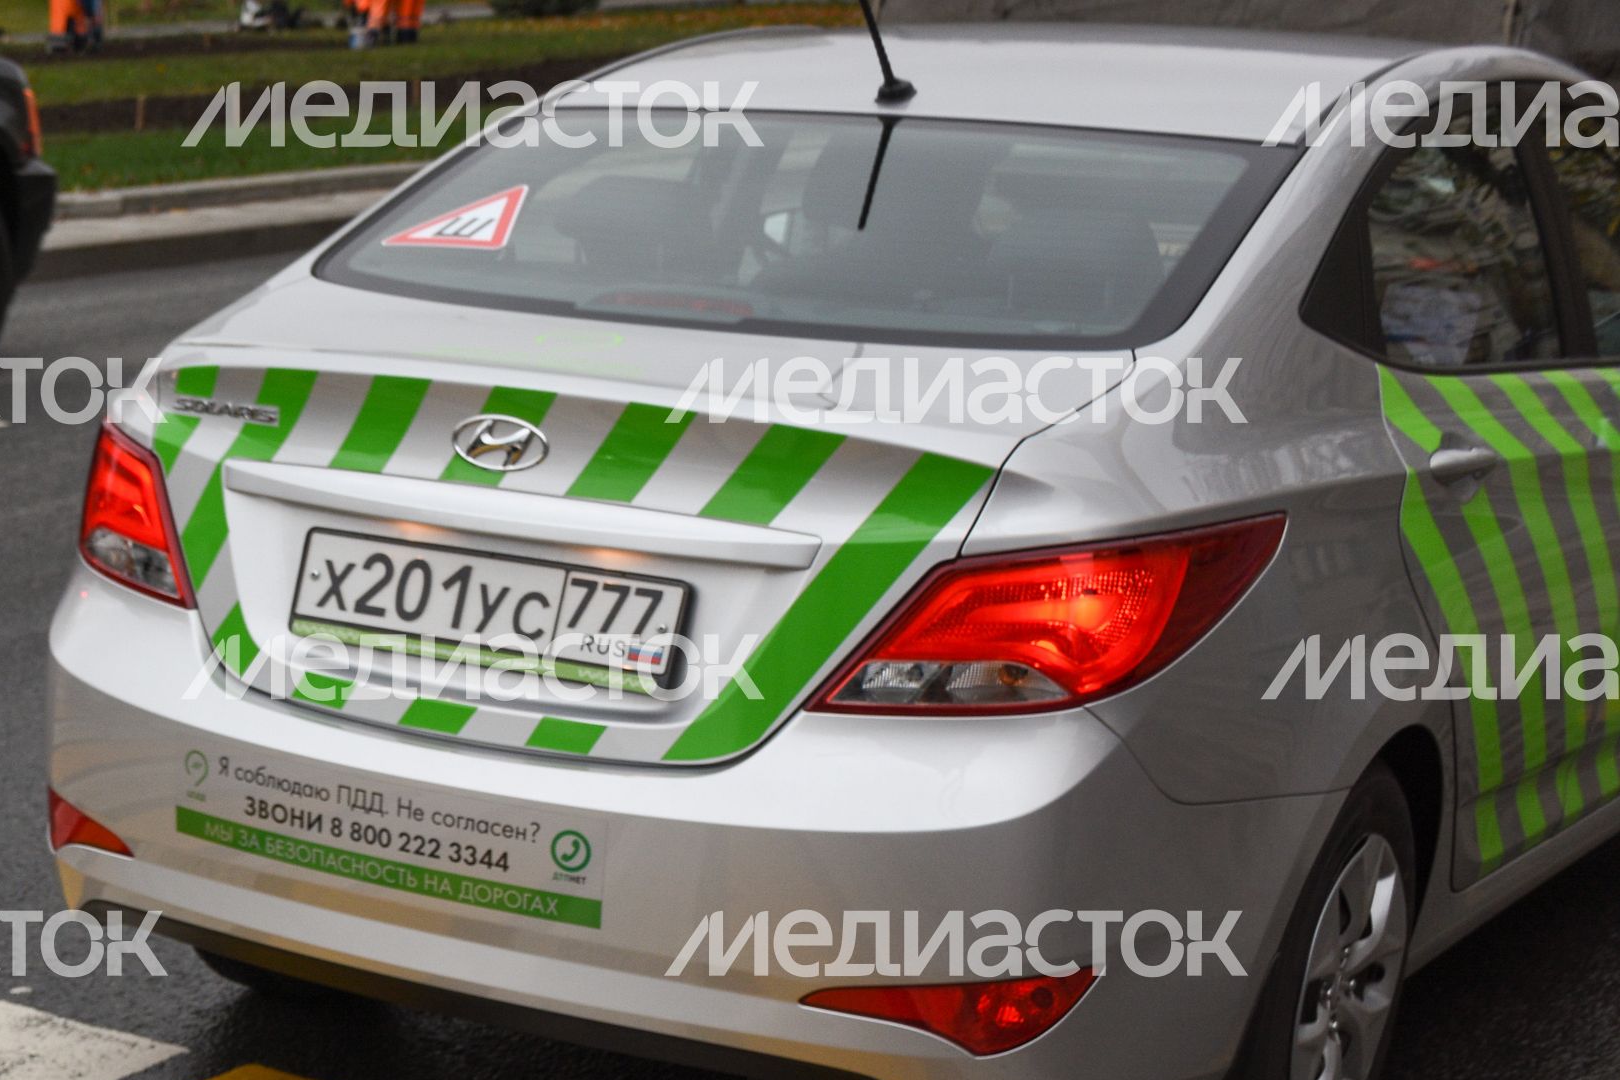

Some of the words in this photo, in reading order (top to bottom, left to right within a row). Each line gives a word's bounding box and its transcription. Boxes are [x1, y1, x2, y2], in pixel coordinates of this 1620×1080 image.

[566, 578, 664, 638] 777
[580, 634, 625, 657] RUS
[218, 756, 230, 776] Я
[235, 763, 330, 802] соблюдаю
[336, 785, 389, 816] ПДД.
[397, 797, 424, 823] Не
[431, 807, 540, 842] согласен?
[243, 796, 323, 832] ЗВОНИ
[330, 817, 344, 838] 8
[350, 820, 391, 849] 800
[398, 831, 441, 860] 222
[448, 841, 510, 873] 3344
[204, 820, 234, 842] МЫ
[238, 828, 262, 851] ЗА
[265, 838, 418, 888] БЕЗОПАСНОСТЬ
[424, 872, 454, 895] НА
[459, 881, 559, 916] ДОРОГАХ
